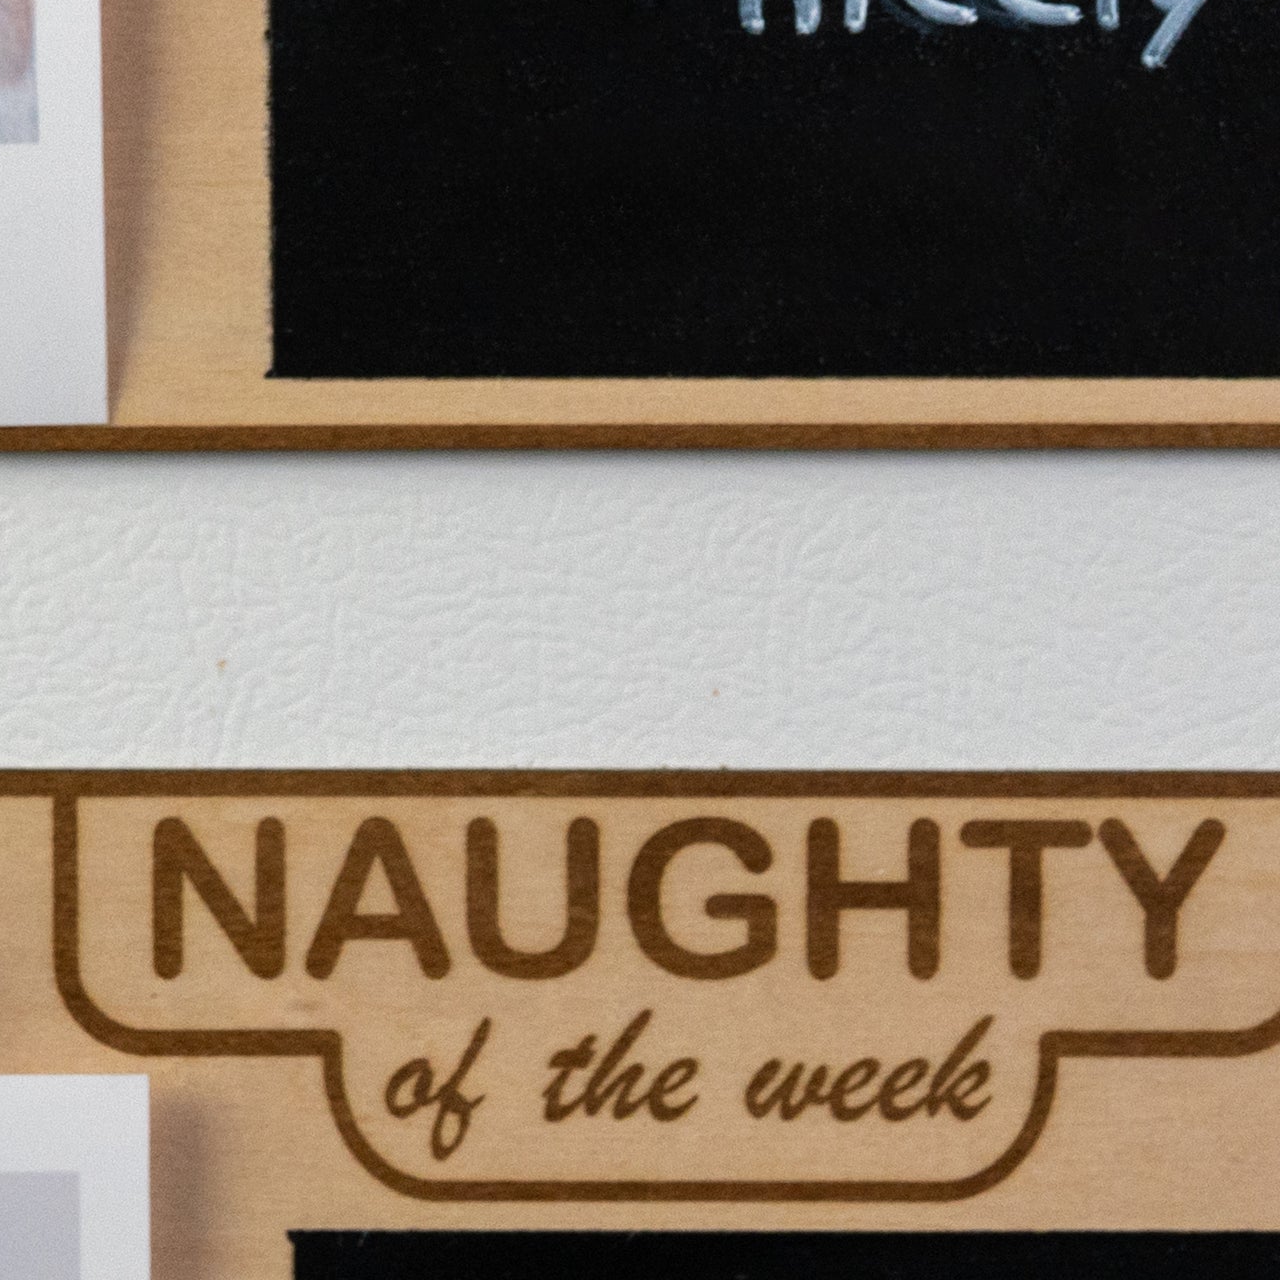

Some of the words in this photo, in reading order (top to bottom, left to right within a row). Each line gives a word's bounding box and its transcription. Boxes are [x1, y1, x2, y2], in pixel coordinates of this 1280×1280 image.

[152, 816, 1227, 982] NAUGHTY
[384, 1016, 491, 1161] of
[542, 1009, 700, 1124] the
[744, 1014, 995, 1123] week
